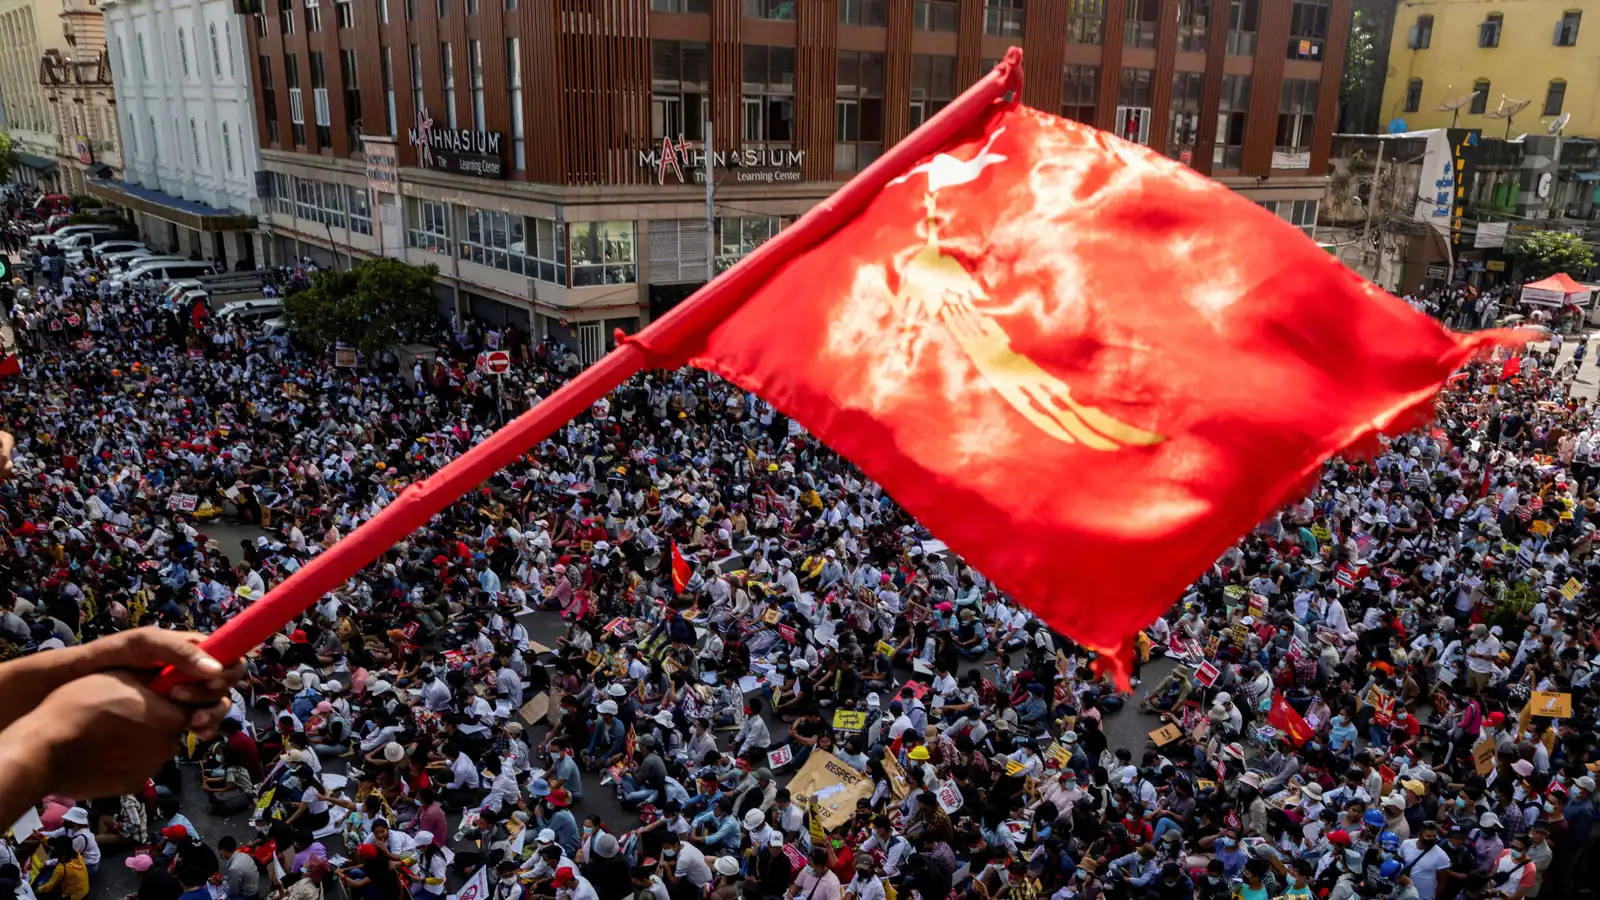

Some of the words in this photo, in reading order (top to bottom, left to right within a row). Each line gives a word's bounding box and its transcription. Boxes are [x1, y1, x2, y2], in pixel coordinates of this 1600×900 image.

[437, 155, 447, 167] The
[459, 158, 482, 175] Learning
[481, 160, 500, 174] Center
[695, 171, 707, 182] Th
[737, 171, 773, 183] Learning
[774, 171, 800, 181] Center
[825, 761, 861, 786] RESPECT
